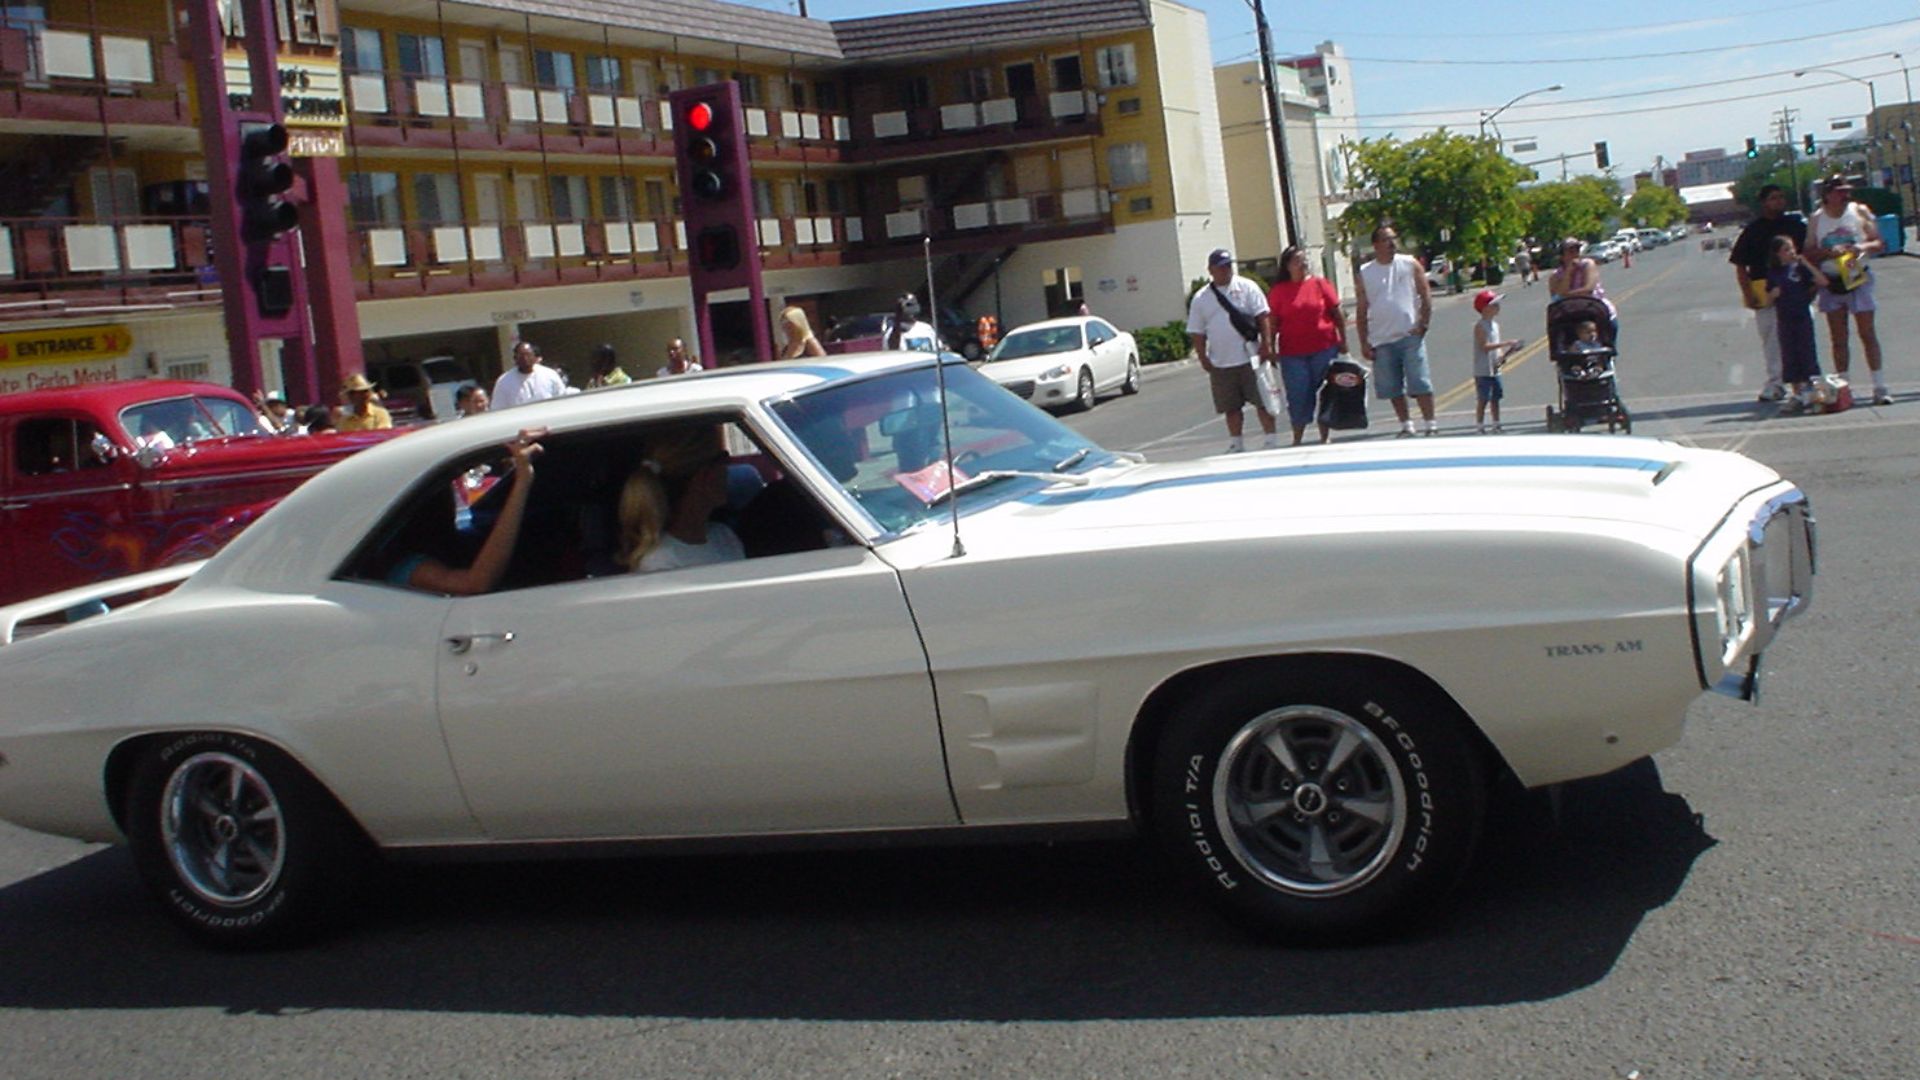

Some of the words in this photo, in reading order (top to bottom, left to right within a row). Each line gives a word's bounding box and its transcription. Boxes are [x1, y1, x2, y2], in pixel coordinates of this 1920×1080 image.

[16, 336, 95, 355] ENTRANCE
[73, 364, 117, 385] Motel
[1544, 644, 1605, 657] TRANS
[1614, 640, 1644, 654] AM
[1186, 753, 1204, 793] T/A
